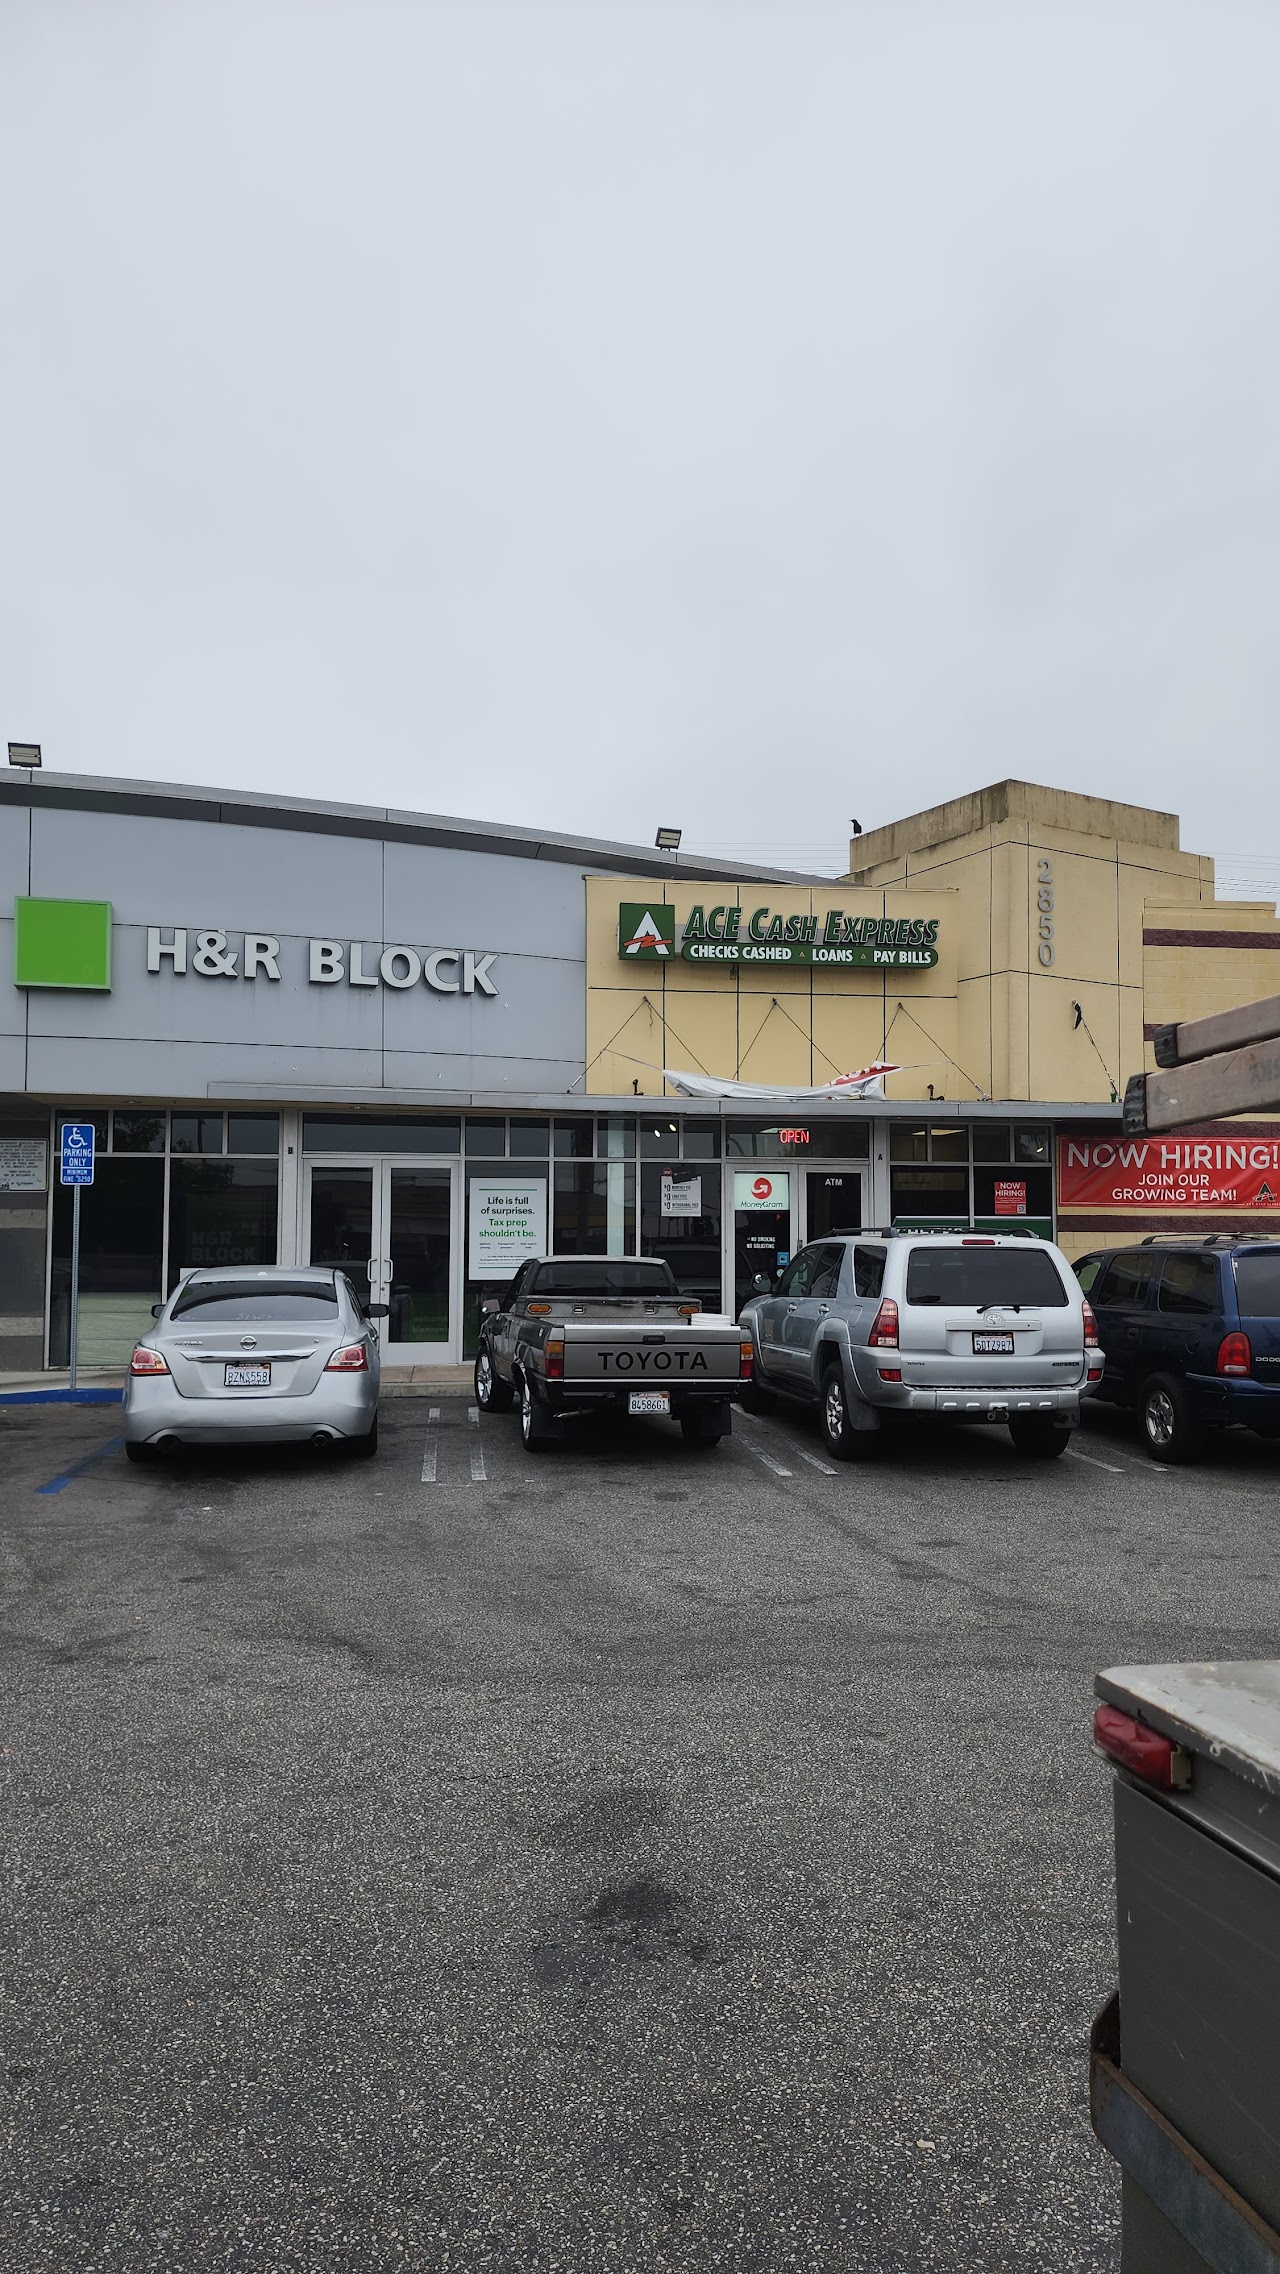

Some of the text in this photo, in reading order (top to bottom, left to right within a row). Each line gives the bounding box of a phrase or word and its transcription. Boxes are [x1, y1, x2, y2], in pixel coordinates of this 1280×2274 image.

[1038, 858, 1055, 966] 2850
[682, 905, 940, 945] ACE CASH EXPRESS
[690, 945, 931, 964] CHECKS CASHED LOANS PAY BILLS
[147, 927, 499, 997] H&R BLOCK
[779, 1129, 809, 1144] OPEN
[63, 1148, 92, 1157] PARKING
[877, 1153, 883, 1161] A
[1068, 1143, 1279, 1170] NOW HIRING!
[68, 1157, 87, 1166] ONLY
[824, 1178, 843, 1186] ATM
[1138, 1174, 1209, 1187] JOIN OUR
[1000, 1182, 1021, 1190] NOW
[995, 1189, 1026, 1197] HIRING!
[1112, 1188, 1237, 1201] GROWING TEAM!
[487, 1196, 529, 1205] Life is full
[740, 1201, 783, 1209] MoneyGram
[480, 1206, 535, 1216] of surprises.
[489, 1218, 527, 1228] Tax prep
[479, 1229, 537, 1237] shouldn't be.
[598, 1351, 708, 1371] TOYOTA
